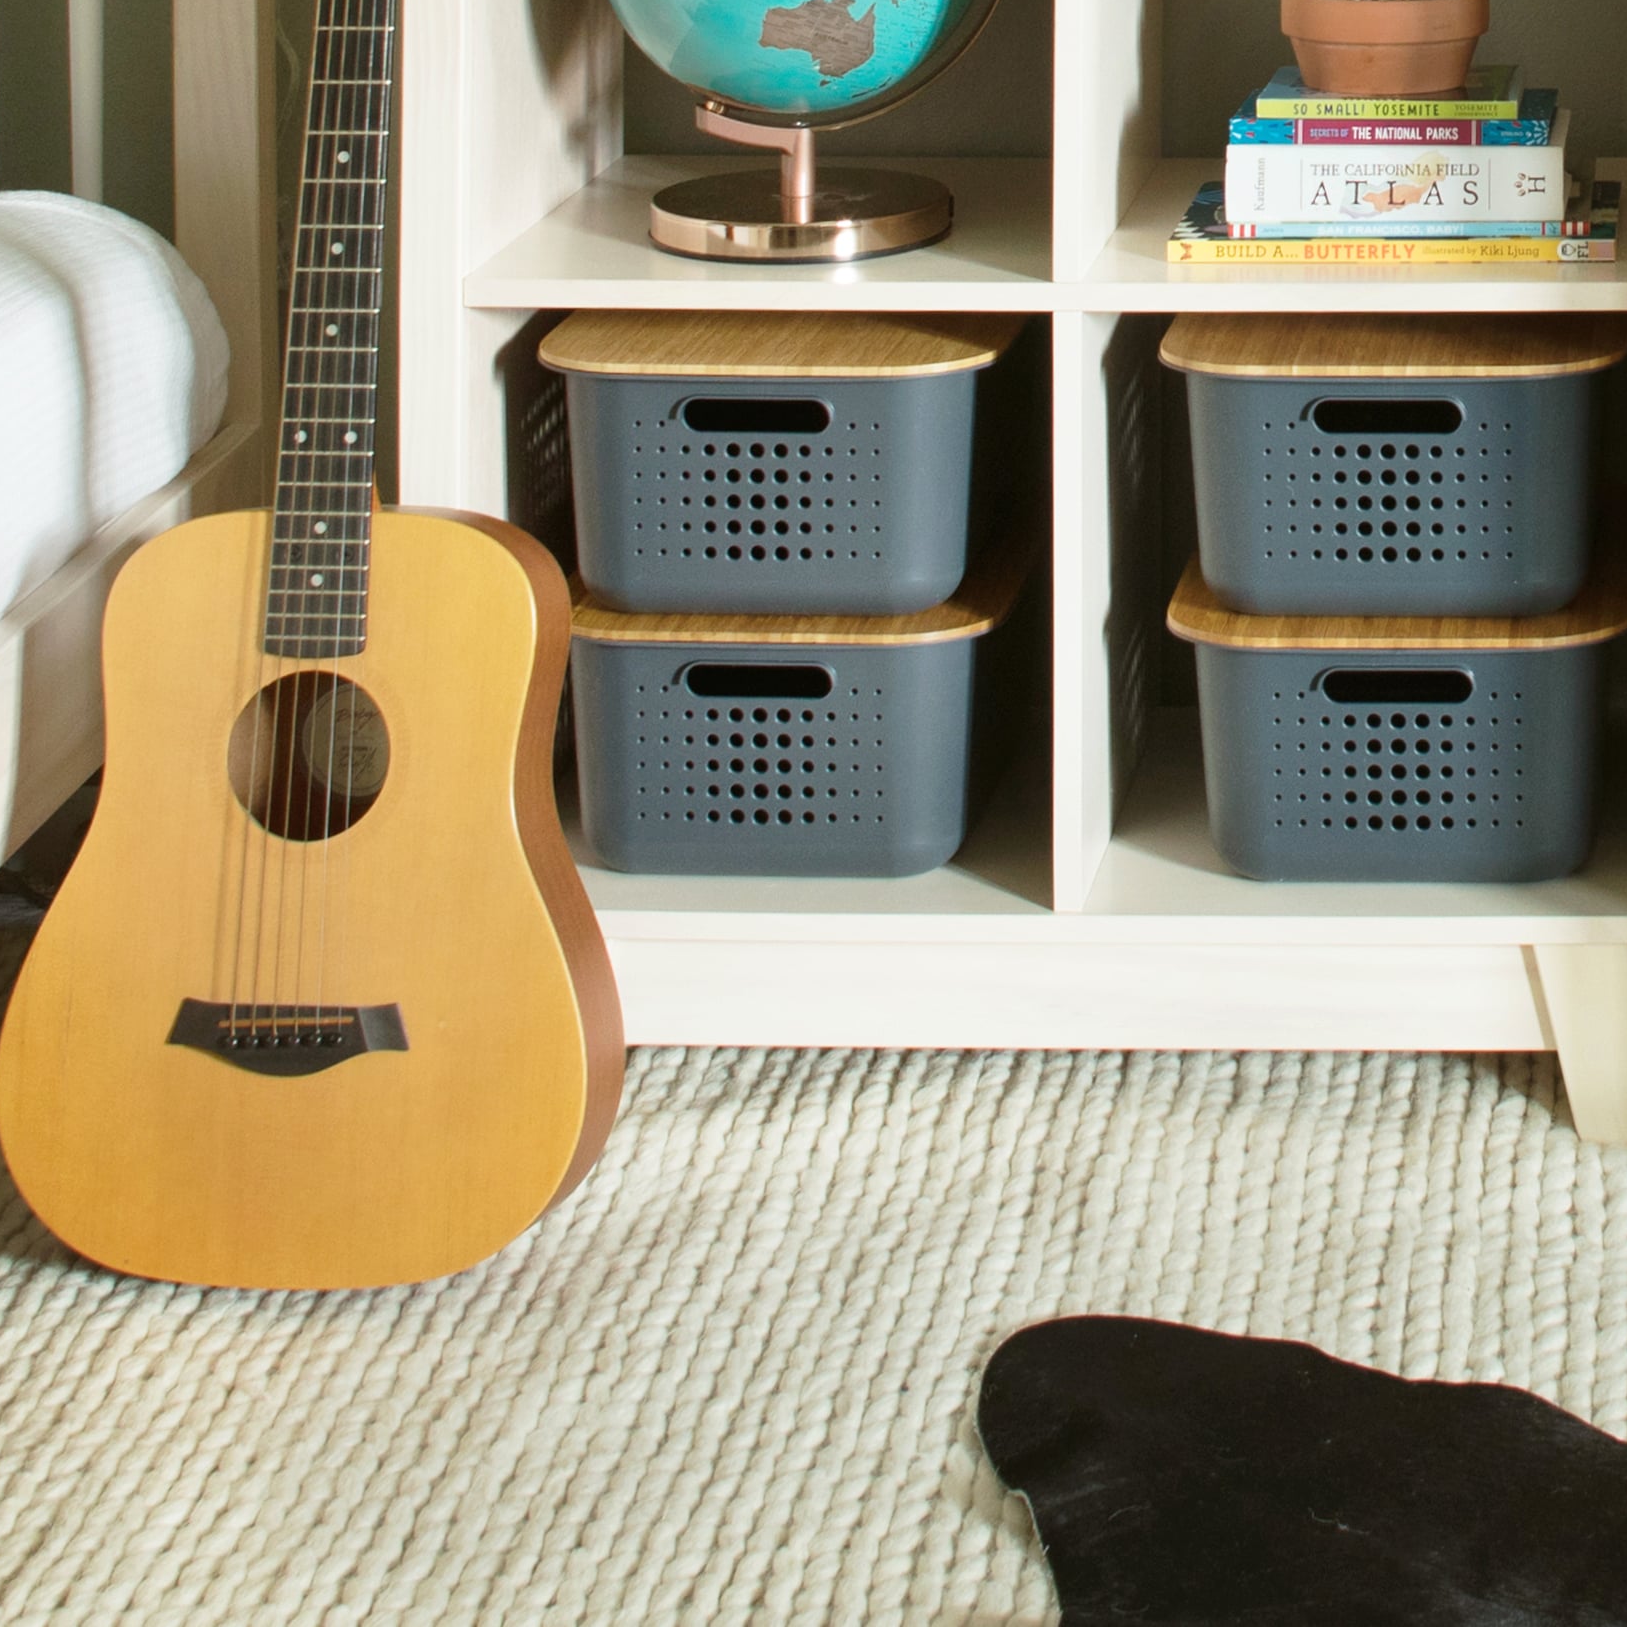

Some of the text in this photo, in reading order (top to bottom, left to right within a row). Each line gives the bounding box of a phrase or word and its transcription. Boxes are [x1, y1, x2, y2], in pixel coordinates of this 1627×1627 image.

[1292, 103, 1441, 116] SO SMALL! YOSEMITE
[1351, 126, 1372, 140] THE
[1374, 126, 1423, 141] NATIONAL
[1425, 126, 1460, 141] PARKS
[1310, 163, 1481, 177] THE CALIFORNIA FIELD
[1252, 156, 1266, 212] Kaufmann
[1310, 180, 1480, 206] ATLAS
[1317, 225, 1344, 235] SAN
[1215, 244, 1268, 259] BUILD
[1303, 244, 1416, 260] BUTTERFLY
[1422, 245, 1541, 258] illustrated by Kiki Ljung
